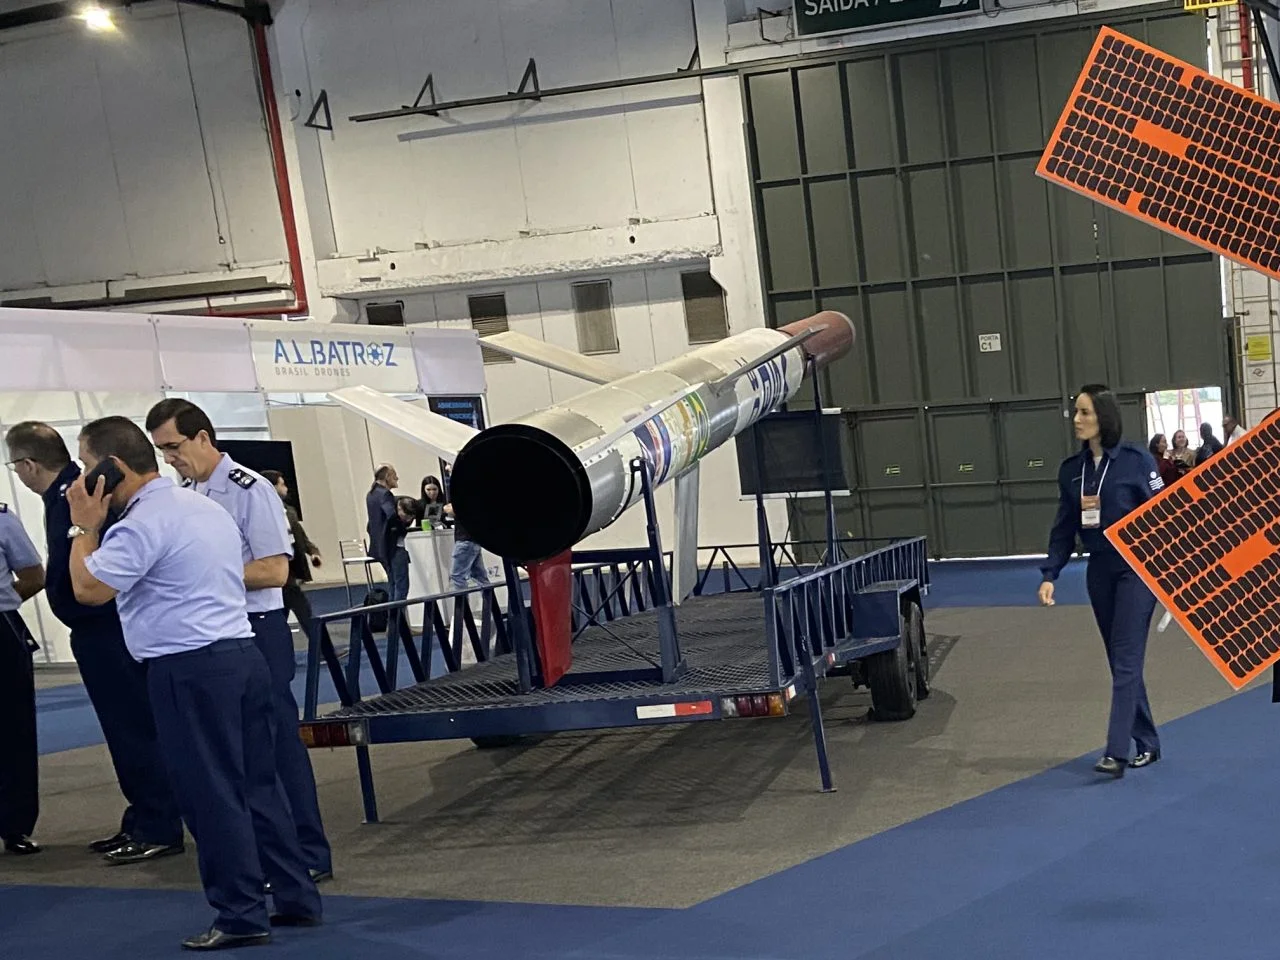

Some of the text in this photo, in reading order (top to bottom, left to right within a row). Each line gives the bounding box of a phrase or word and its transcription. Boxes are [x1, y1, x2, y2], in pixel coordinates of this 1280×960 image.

[982, 342, 992, 350] C1
[274, 338, 399, 367] ALBATROZ
[274, 366, 351, 378] BRASIL DRONES
